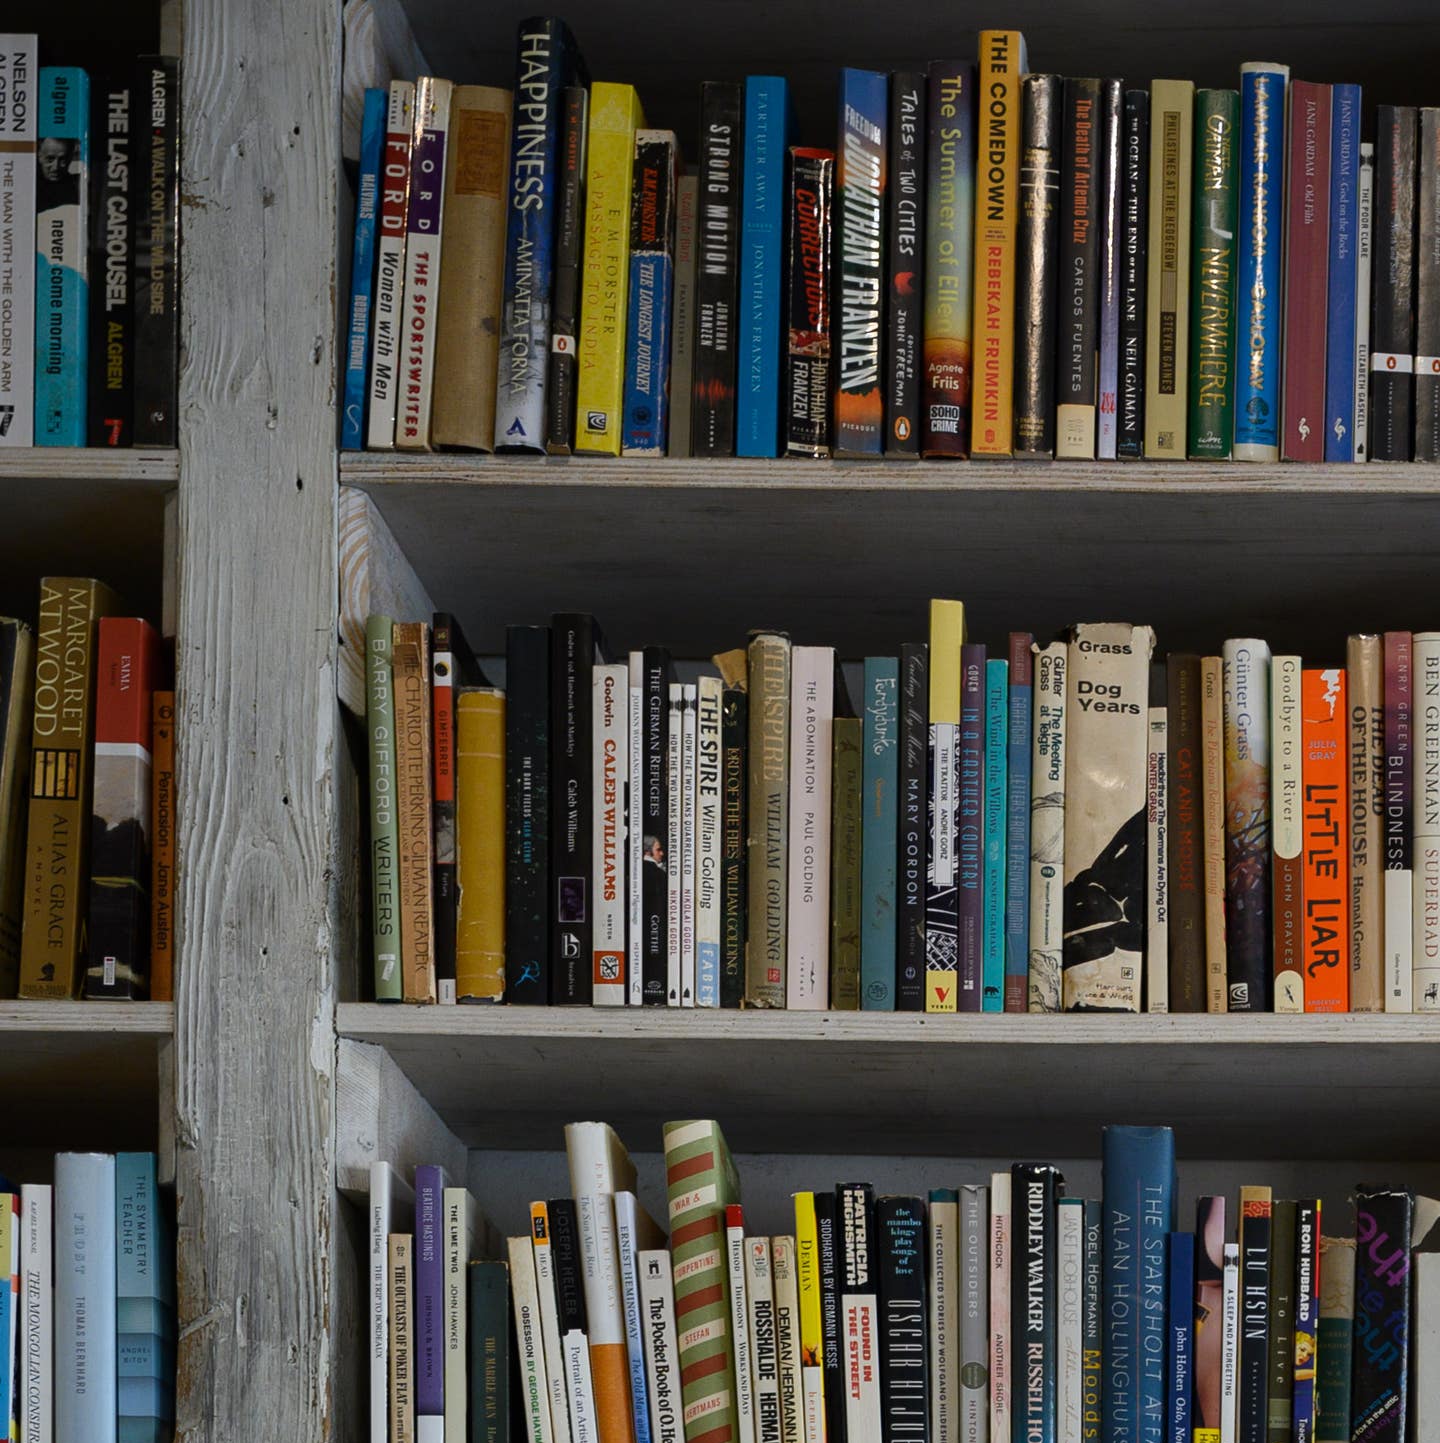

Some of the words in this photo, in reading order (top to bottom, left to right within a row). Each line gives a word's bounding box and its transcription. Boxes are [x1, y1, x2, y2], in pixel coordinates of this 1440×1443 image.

[989, 35, 1008, 74] THE
[107, 90, 128, 132] THE
[512, 33, 550, 211] HAPPINESS
[107, 138, 127, 192] LAST
[986, 81, 1007, 221] COMEDOWN
[50, 219, 65, 261] never
[106, 197, 127, 310] CAROUSEL
[50, 267, 64, 308] come
[511, 238, 535, 328] AMINATTA
[984, 246, 1002, 329] REBEKAH
[48, 312, 64, 374] morning
[106, 321, 123, 389] ALGREN
[510, 333, 529, 393] FORNA
[984, 337, 1000, 421] FRUMKIN
[34, 584, 63, 736] ATWOOD
[62, 586, 87, 737] MARGARET
[1425, 656, 1440, 696] BEN
[700, 694, 717, 735] THE
[604, 740, 618, 804] CALEB
[699, 741, 717, 796] SPIRE
[1424, 705, 1439, 826] GREENMAN
[50, 813, 69, 878] ALIAS
[603, 809, 616, 901] WILLIAMS
[702, 805, 716, 852] William
[1306, 784, 1339, 879] LITTLE
[698, 855, 715, 910] Golding
[1424, 849, 1439, 957] SUPERBAD
[48, 884, 66, 949] GRACE
[1308, 899, 1341, 976] LIAR
[1027, 1181, 1046, 1259] RIDDLEY
[1143, 1185, 1162, 1230] THE
[1111, 1211, 1131, 1271] ALAN
[75, 1296, 86, 1338] THOMAS
[1026, 1261, 1045, 1331] WALKER
[1143, 1238, 1163, 1379] SPARSHOLT
[75, 1342, 85, 1394] BERNHARD
[1027, 1341, 1045, 1416] RUSSELL
